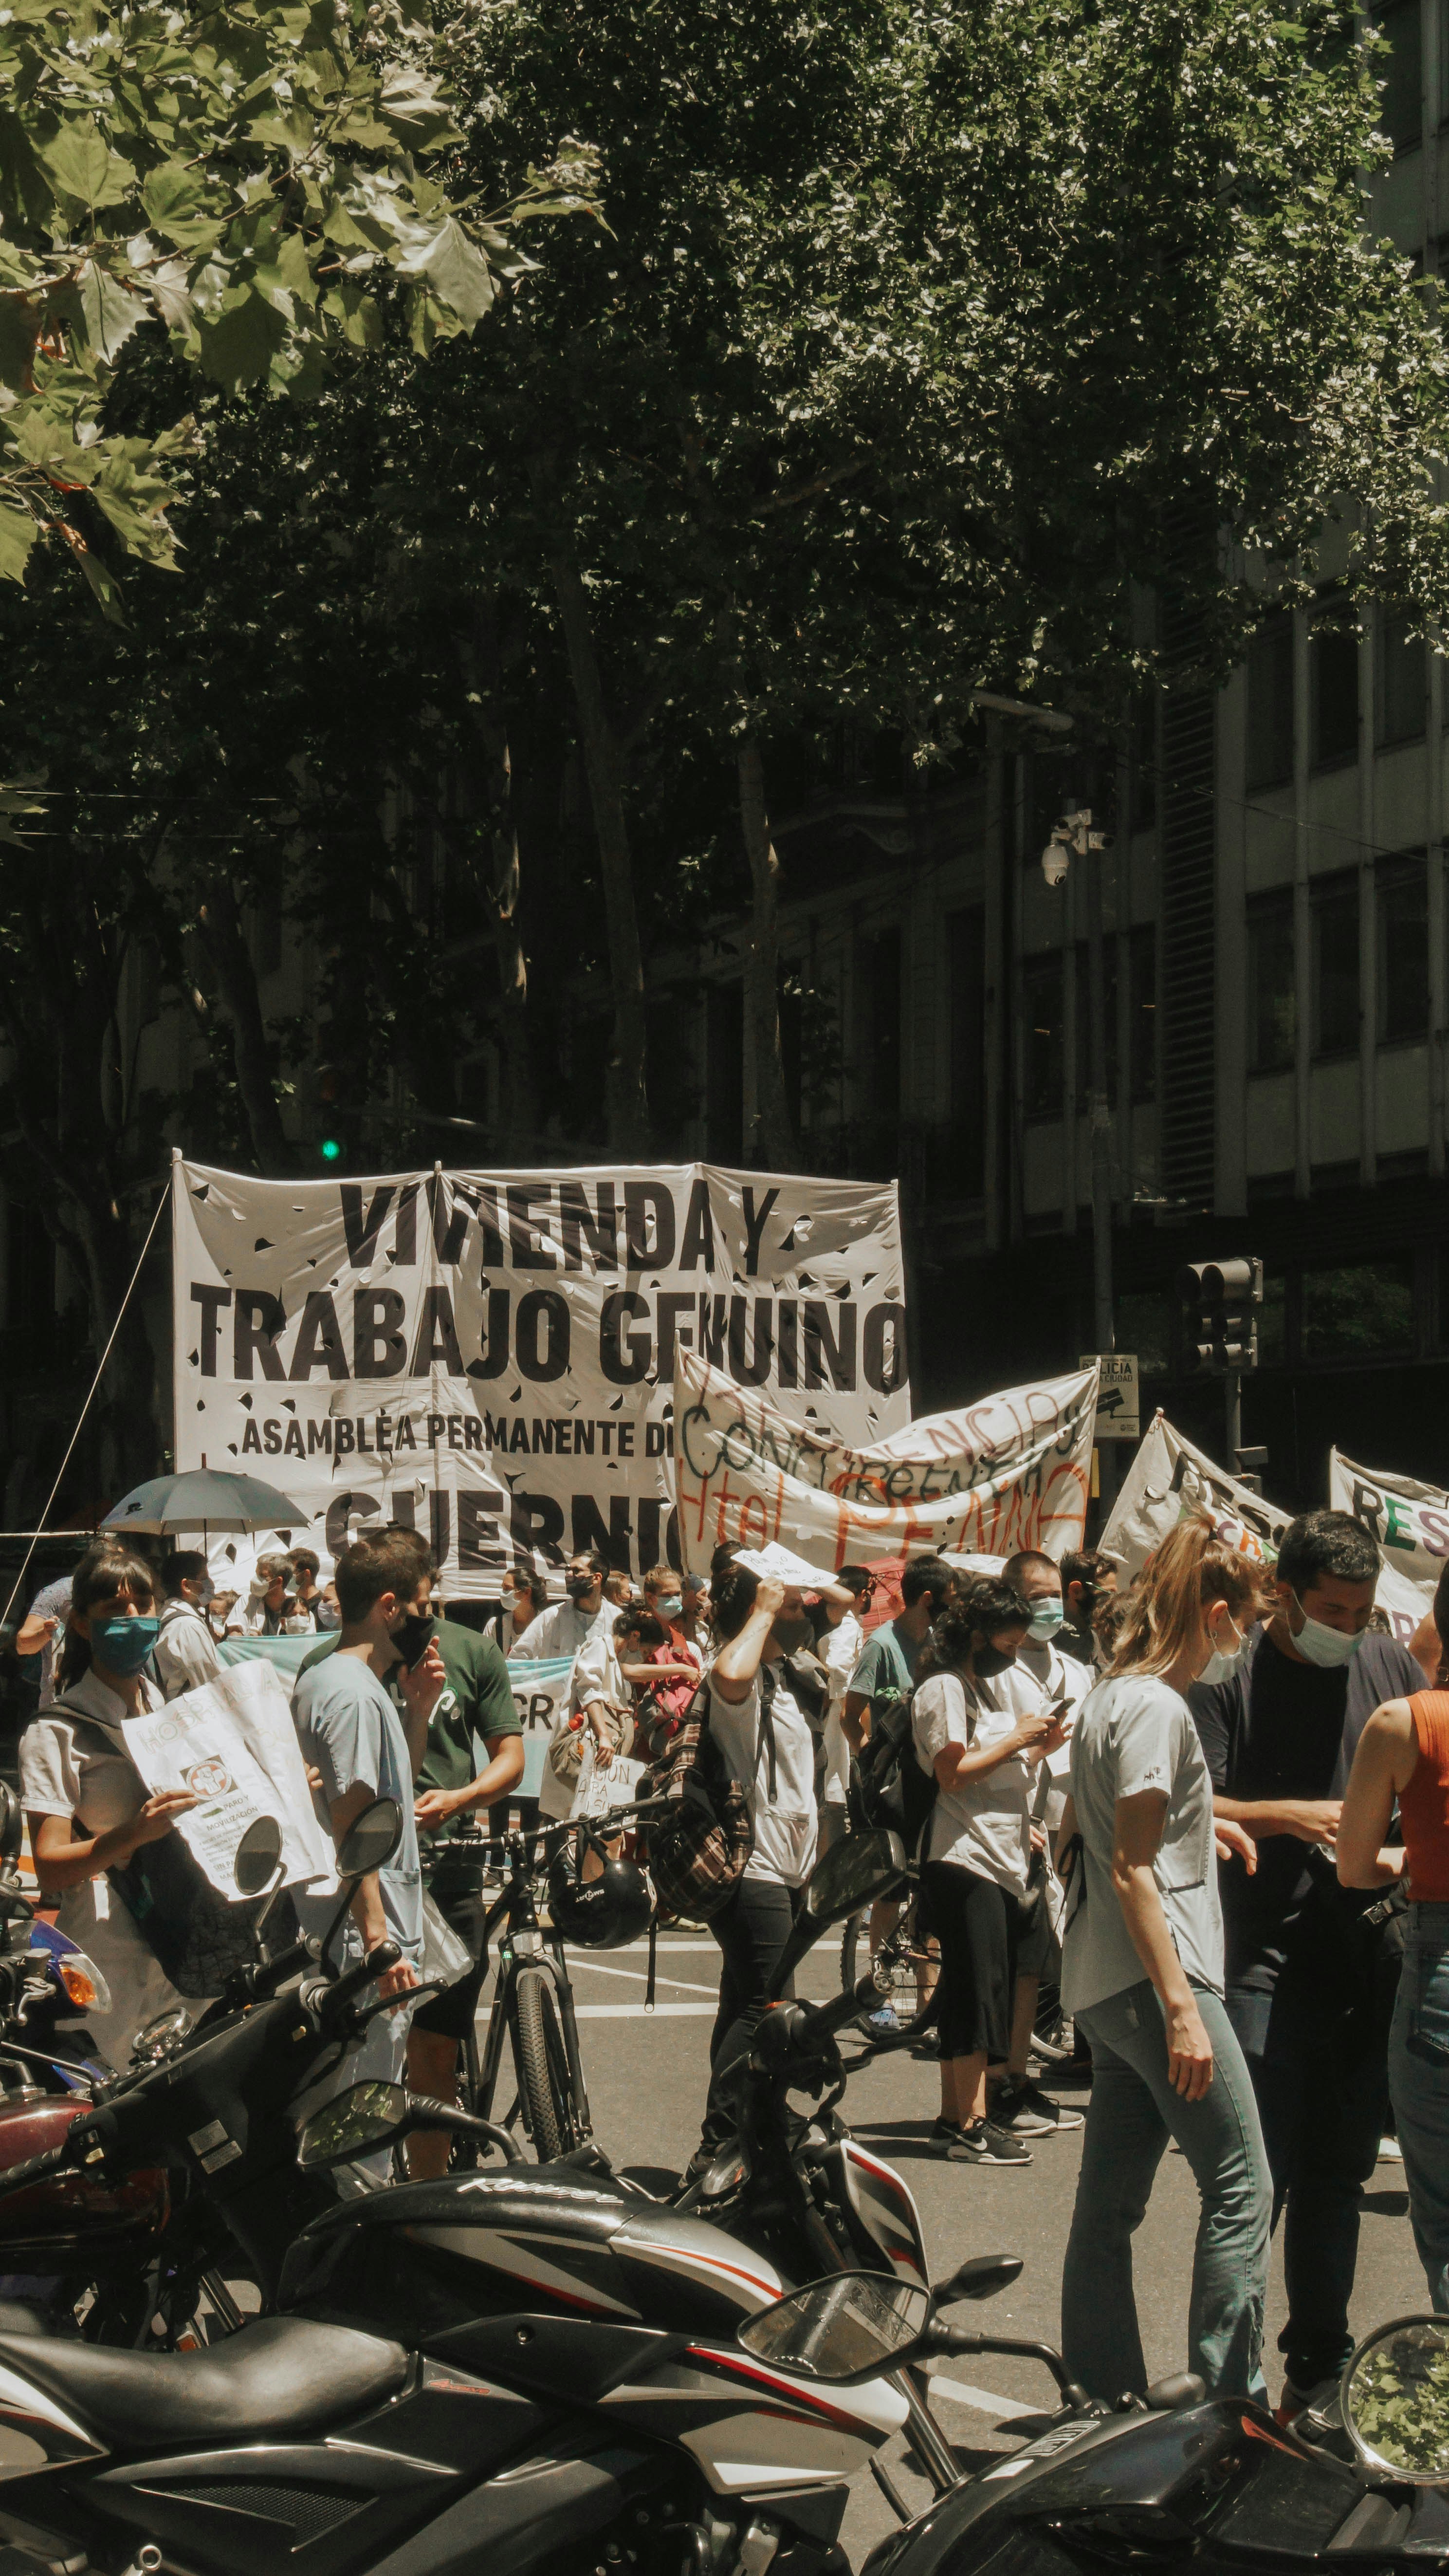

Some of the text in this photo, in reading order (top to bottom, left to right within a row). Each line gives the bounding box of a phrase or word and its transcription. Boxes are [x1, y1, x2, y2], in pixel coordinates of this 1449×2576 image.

[340, 1179, 780, 1276] VIVIENDA Y
[190, 1281, 909, 1393] TRABAJO GENUINO
[241, 1414, 674, 1458] ASAMBLEA PERMANENTE D
[828, 1462, 1087, 1572] PENNA
[206, 1806, 258, 1831] MOVILIZACIÓN
[224, 1798, 243, 1810] PARO
